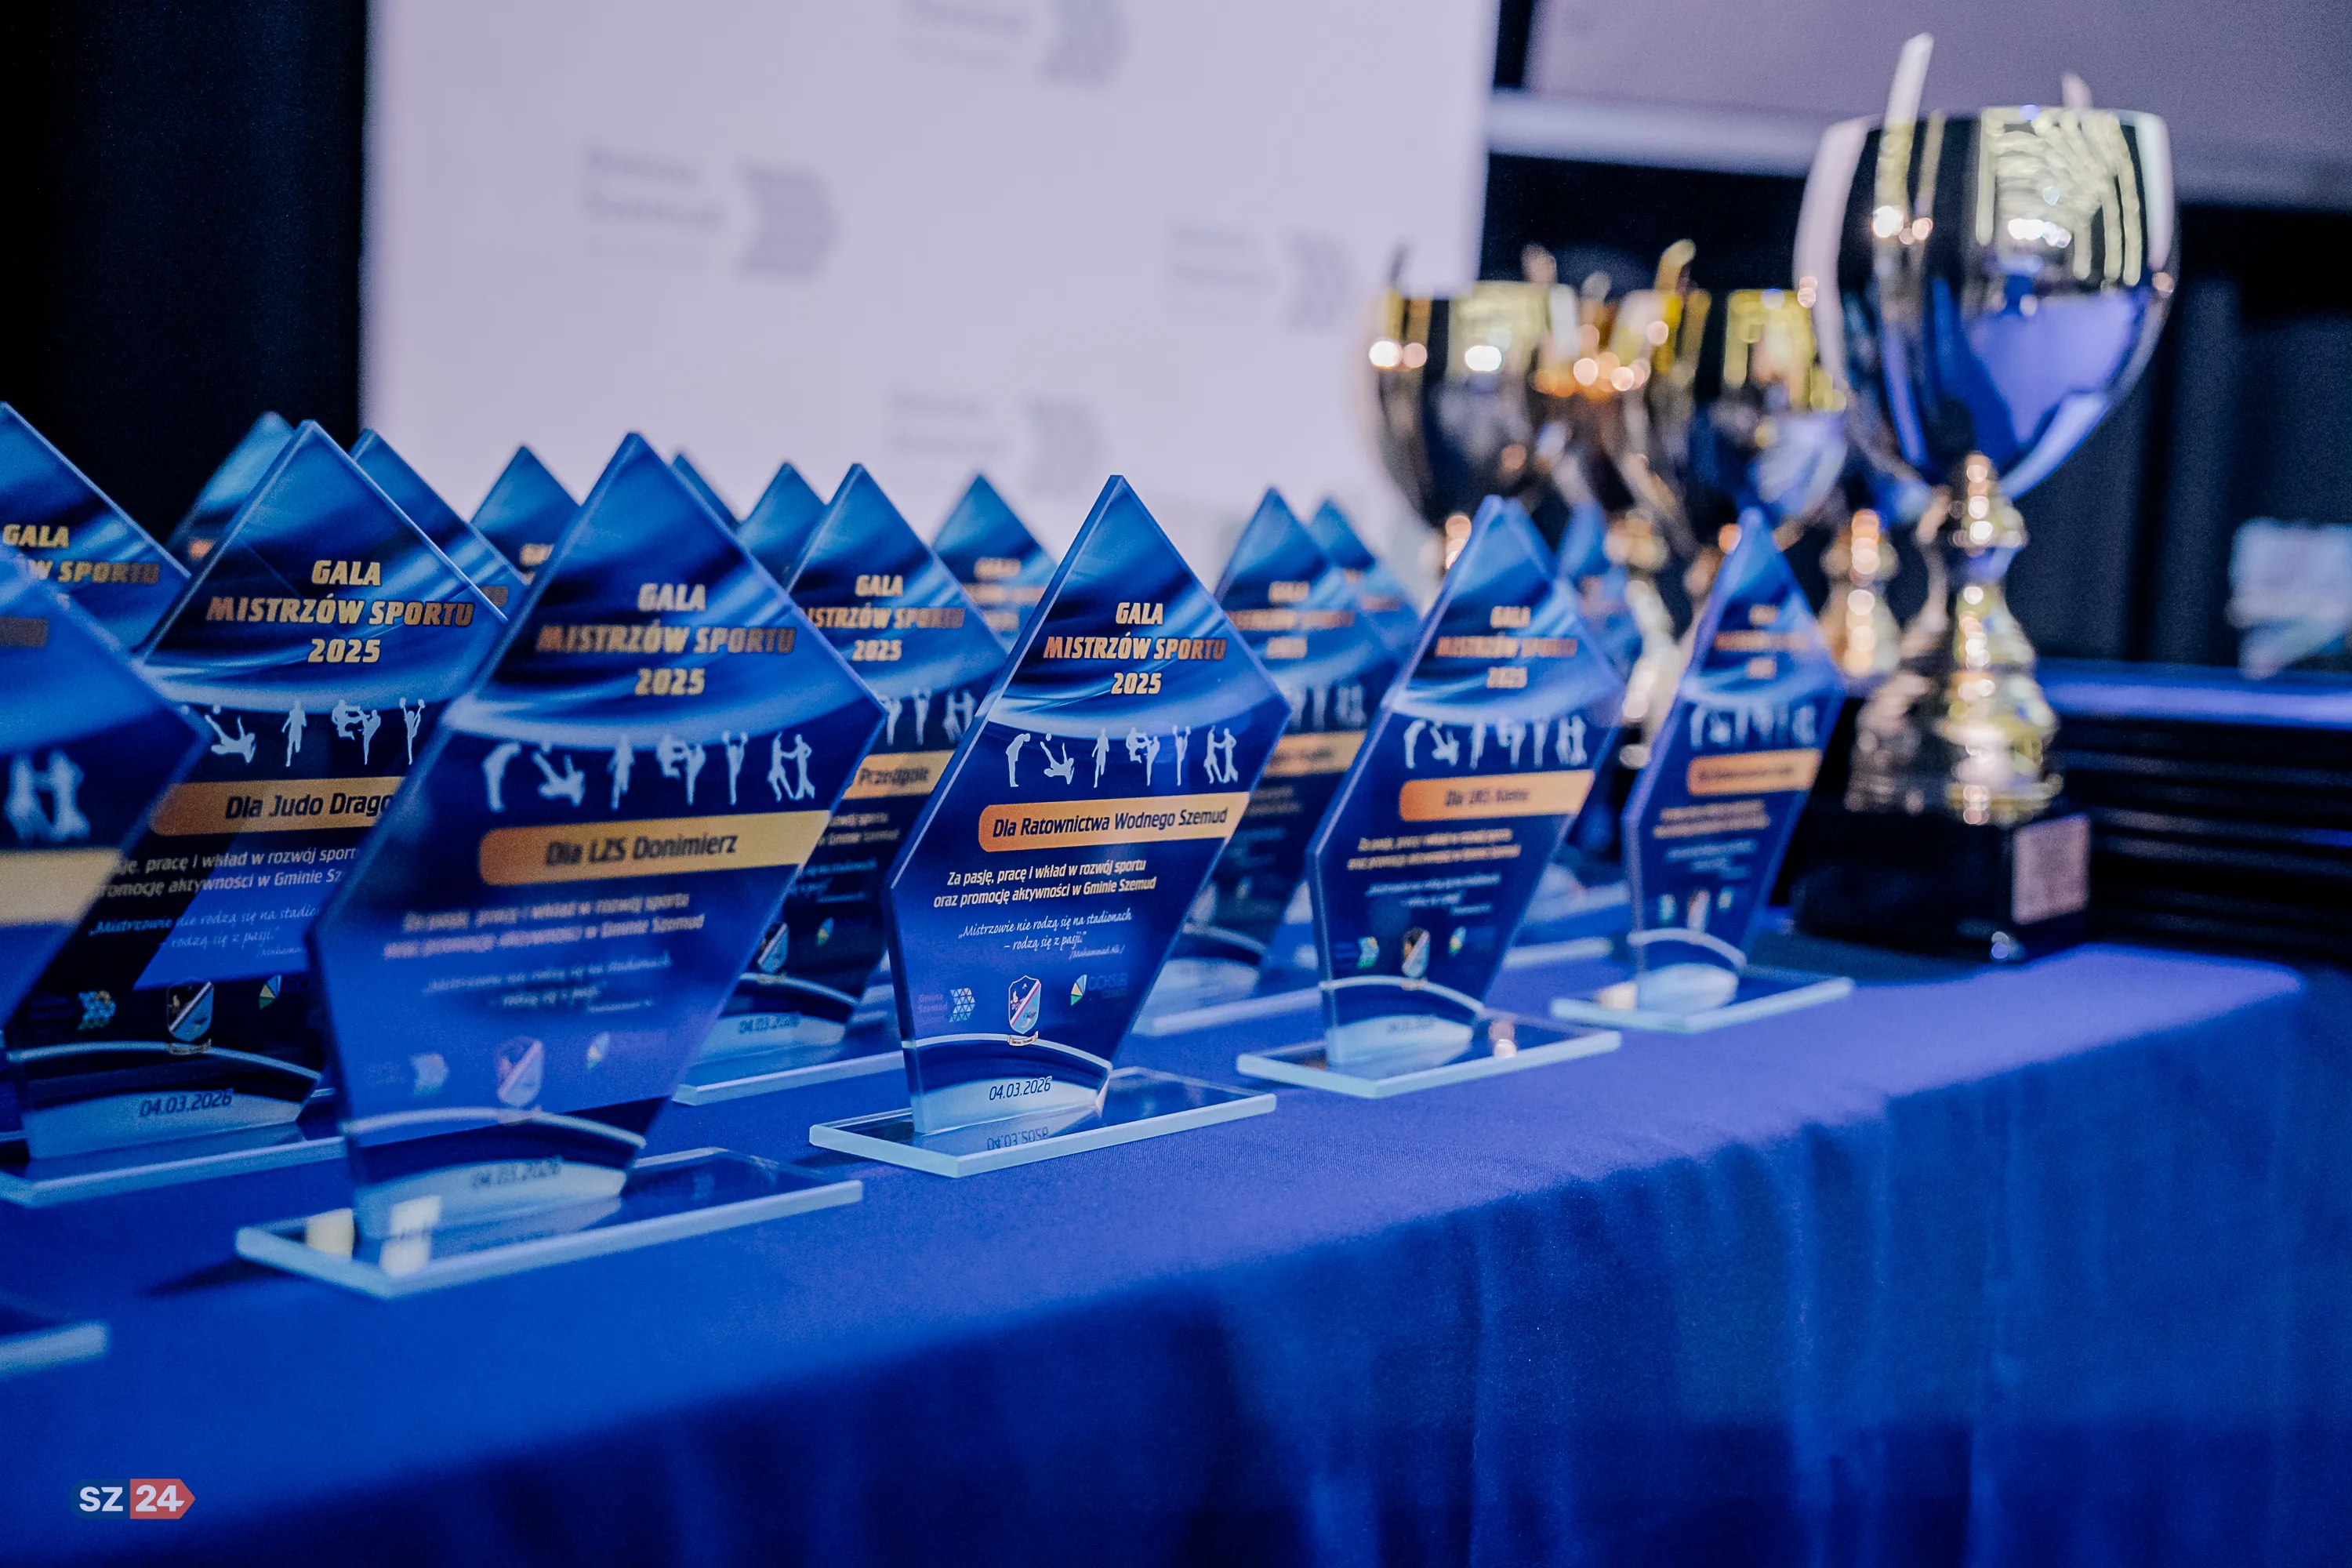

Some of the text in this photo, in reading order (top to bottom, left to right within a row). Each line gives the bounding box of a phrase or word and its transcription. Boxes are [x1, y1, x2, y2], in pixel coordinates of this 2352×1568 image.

[3, 524, 69, 548] GALA
[311, 560, 381, 586] GALA
[855, 575, 903, 597] GALA
[206, 593, 474, 627] MISTRZÓW SPORTU
[637, 583, 706, 612] GALA
[804, 602, 891, 628] ISTRZÓW
[1116, 602, 1163, 625] GALA
[536, 619, 797, 654] MISTRZÓW SPORTU
[1043, 632, 1227, 661] MISTRZÓW SPORTU
[308, 638, 380, 663] 2025
[852, 640, 902, 661] 2025
[635, 668, 706, 696] 2025
[1111, 673, 1162, 695] 2025
[226, 795, 263, 819] Dla
[269, 793, 324, 817] Judo
[993, 808, 1228, 838] Dla Ratownictwa Wodnego Szemud
[252, 853, 264, 865] w
[267, 848, 317, 865] rozwój
[101, 881, 165, 898] romocję
[257, 874, 270, 887] w
[274, 870, 323, 886] Gminie
[947, 858, 1146, 886] Za pasję, pracę i wkład w rozwój sportu
[934, 876, 1156, 909] oraz promocję aktywności w Gminie Szemud
[1017, 918, 1032, 931] nie
[1033, 916, 1059, 932] rodzą
[1060, 916, 1071, 931] się
[1073, 917, 1085, 926] na
[1086, 908, 1132, 926] stadionach
[1012, 935, 1040, 952] rodzą
[1041, 935, 1051, 949] się
[1054, 938, 1060, 946] z
[989, 1076, 1052, 1101] 04.03.2026
[140, 1089, 234, 1117] 04.03.2026
